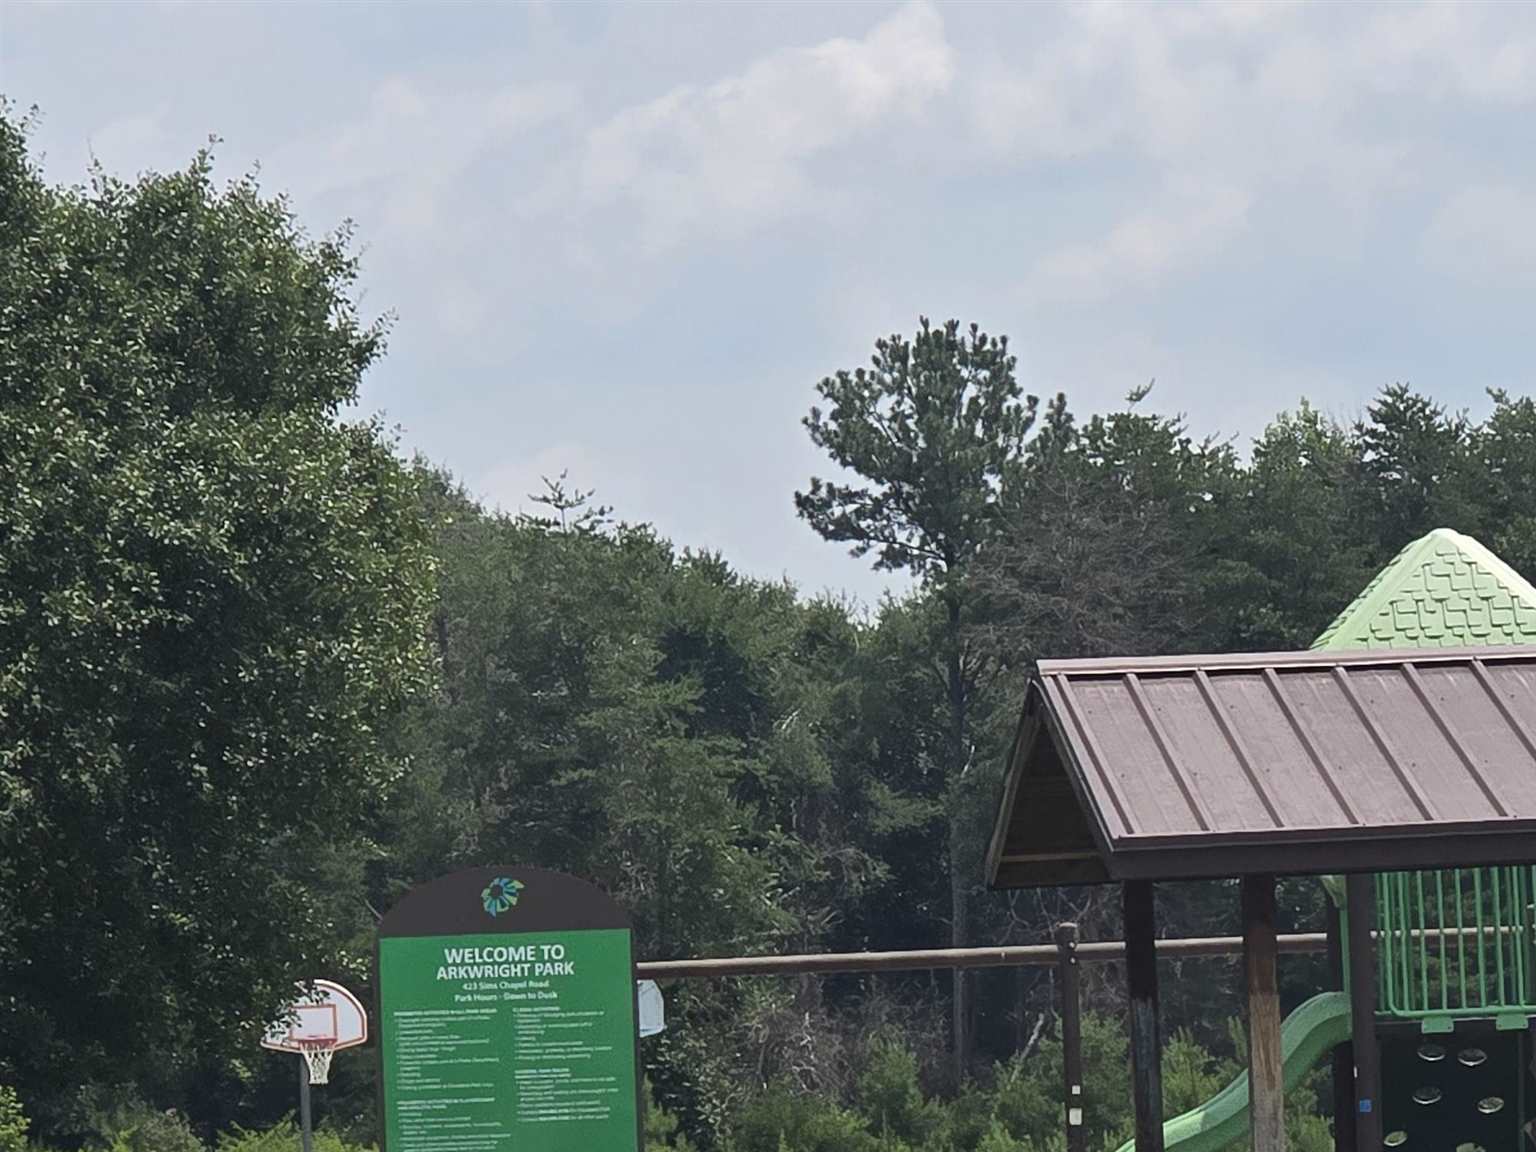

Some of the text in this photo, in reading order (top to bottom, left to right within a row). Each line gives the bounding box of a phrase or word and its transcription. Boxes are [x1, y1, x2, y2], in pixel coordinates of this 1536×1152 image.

[444, 944, 565, 964] WELCOME TO
[436, 961, 575, 980] ARKWRIGHT PARK
[499, 980, 527, 989] Chapel
[528, 979, 550, 988] Road
[454, 994, 472, 1002] Park
[473, 993, 498, 1001] Hours
[537, 990, 558, 999] Dusk
